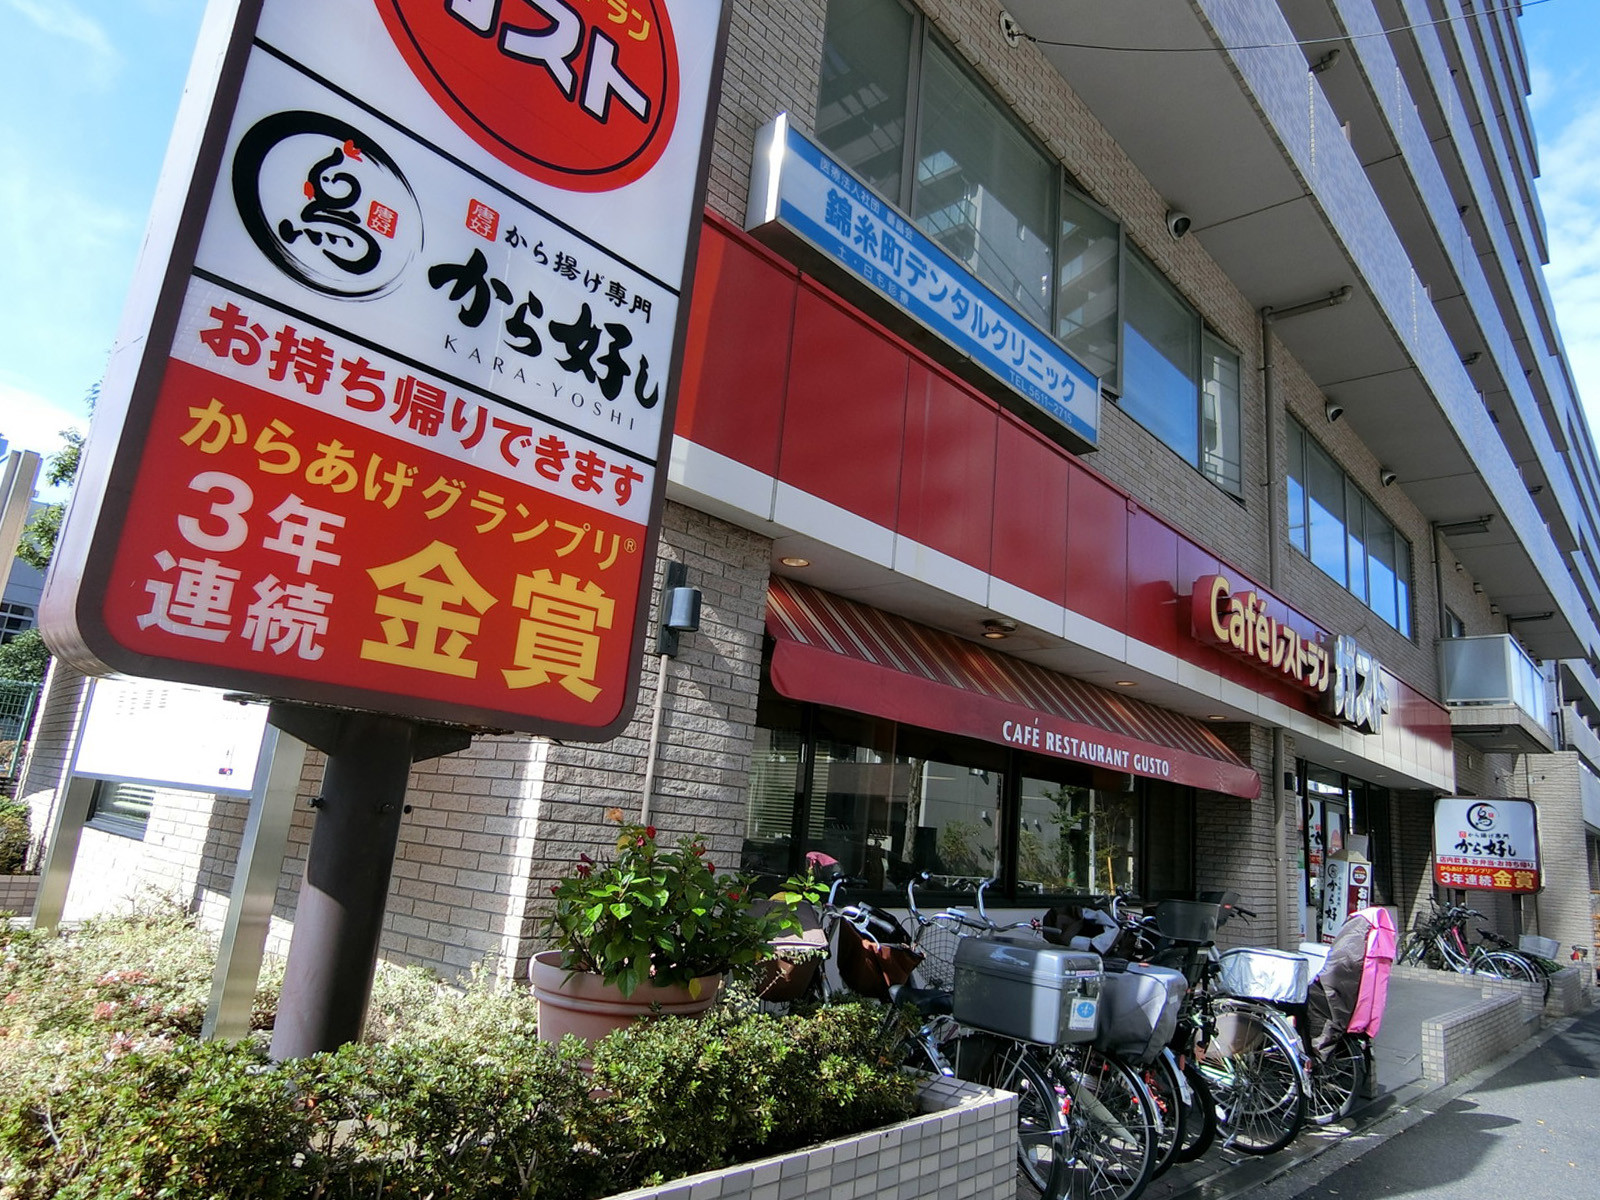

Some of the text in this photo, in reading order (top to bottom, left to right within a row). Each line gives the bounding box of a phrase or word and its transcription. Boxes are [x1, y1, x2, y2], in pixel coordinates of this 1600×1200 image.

[446, 0, 650, 124] スト
[506, 226, 652, 324] から揚げ専門
[825, 188, 1075, 402] 錦糸町デンタルクリニック
[428, 248, 659, 409] から好し
[1009, 370, 1027, 391] TEL
[200, 302, 644, 506] お持ち帰りできます
[444, 334, 634, 430] KARA-YOSHI
[178, 471, 346, 575] 3年
[136, 550, 334, 661] 連続
[359, 540, 616, 703] 金賞
[1334, 634, 1391, 735] ガスト
[1002, 717, 1170, 777] CAFÉ RESTAURANT GUSTO
[1454, 839, 1516, 858] から好し
